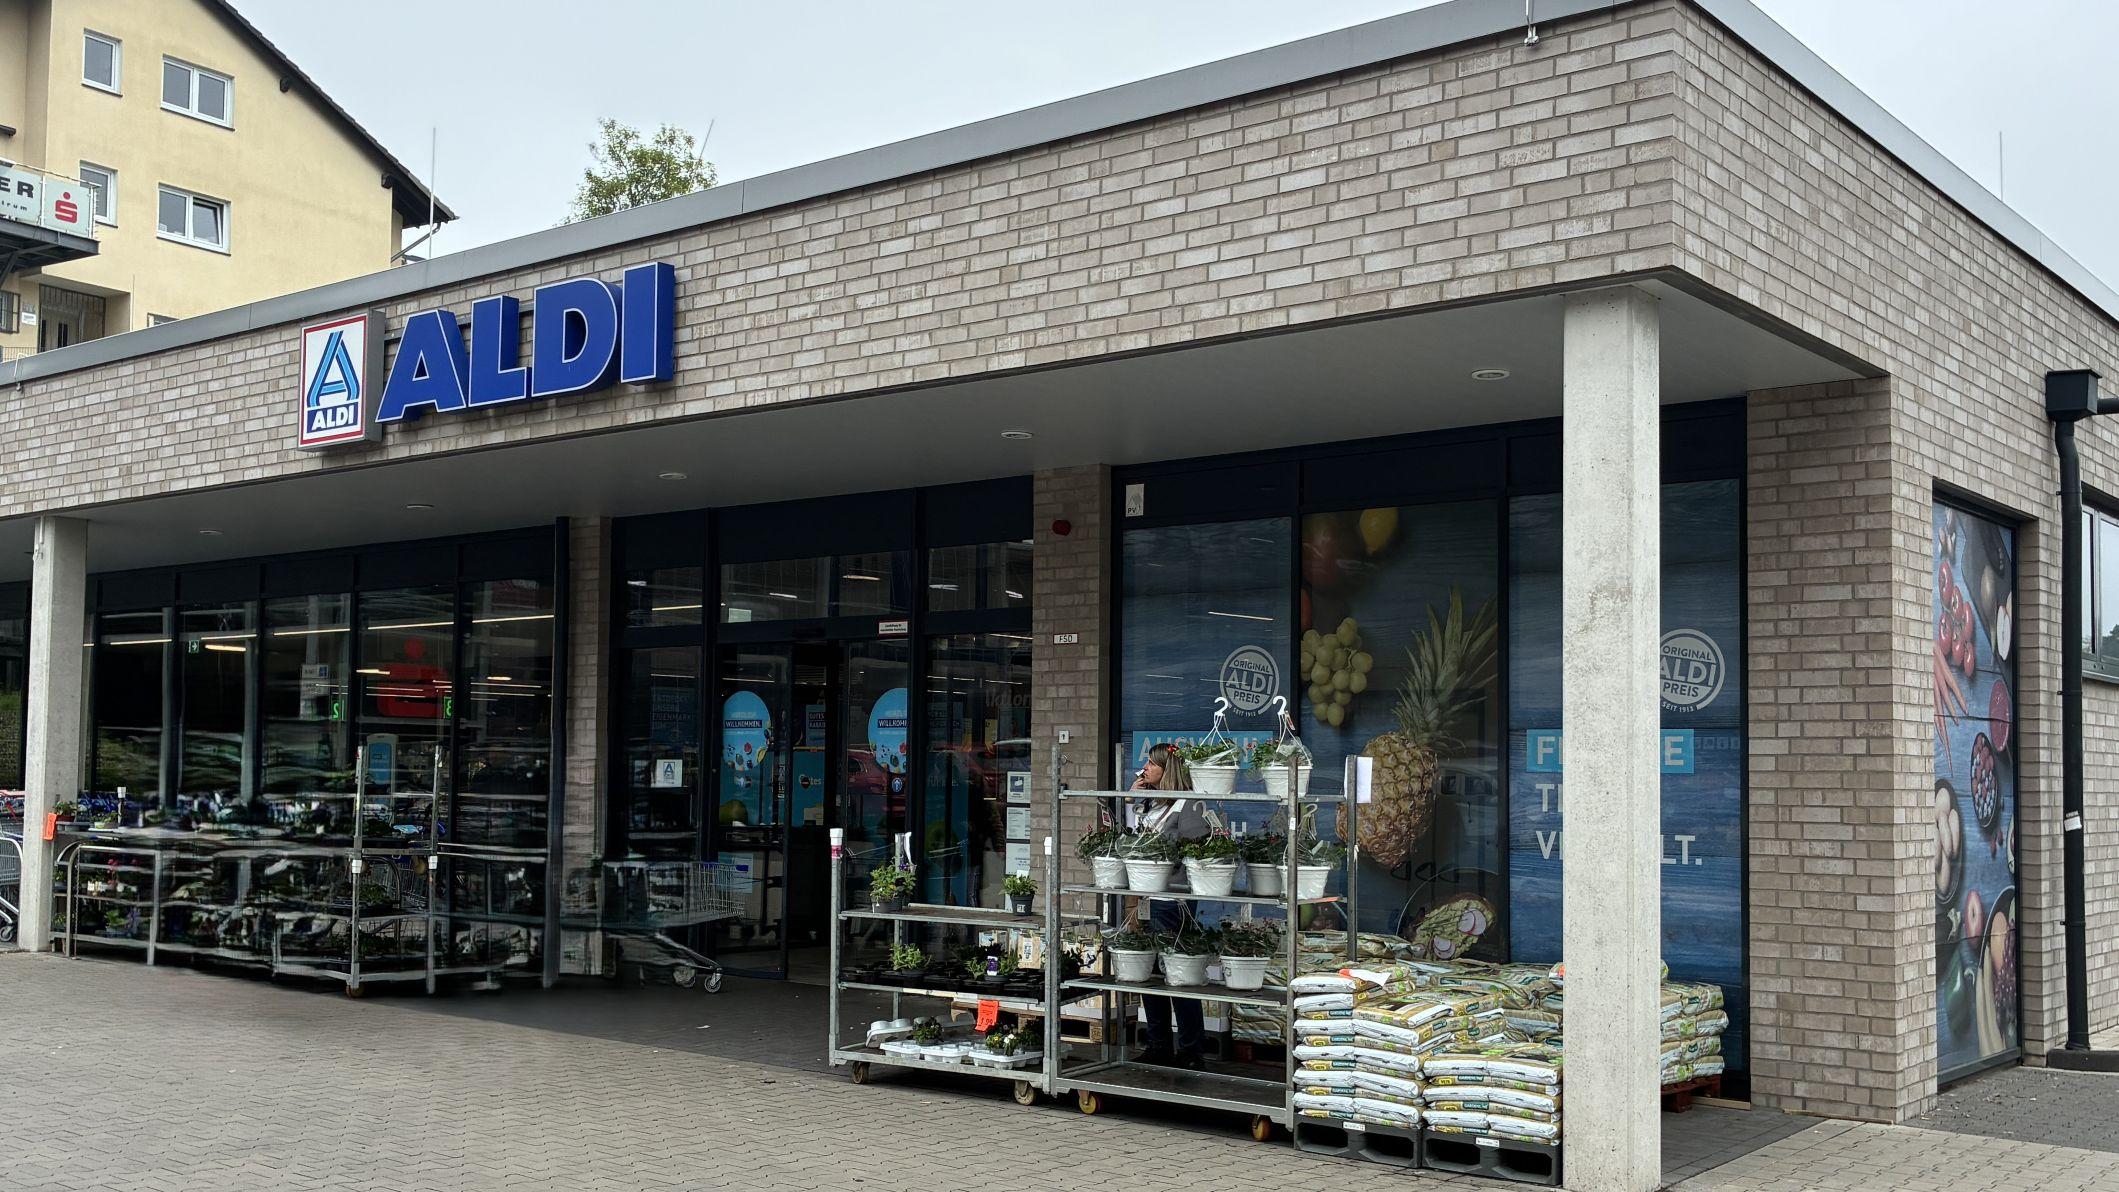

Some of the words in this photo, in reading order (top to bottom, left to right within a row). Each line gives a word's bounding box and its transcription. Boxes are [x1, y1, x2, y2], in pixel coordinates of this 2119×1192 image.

[375, 262, 672, 423] ALDI
[312, 405, 354, 431] ALDI
[1662, 645, 1711, 661] ORIGINAL
[1233, 659, 1270, 673] ORIGINAL
[1660, 656, 1717, 686] ALDI
[1225, 669, 1274, 695] ALDI
[1662, 681, 1699, 698] PREIS
[1233, 690, 1261, 704] PREIS
